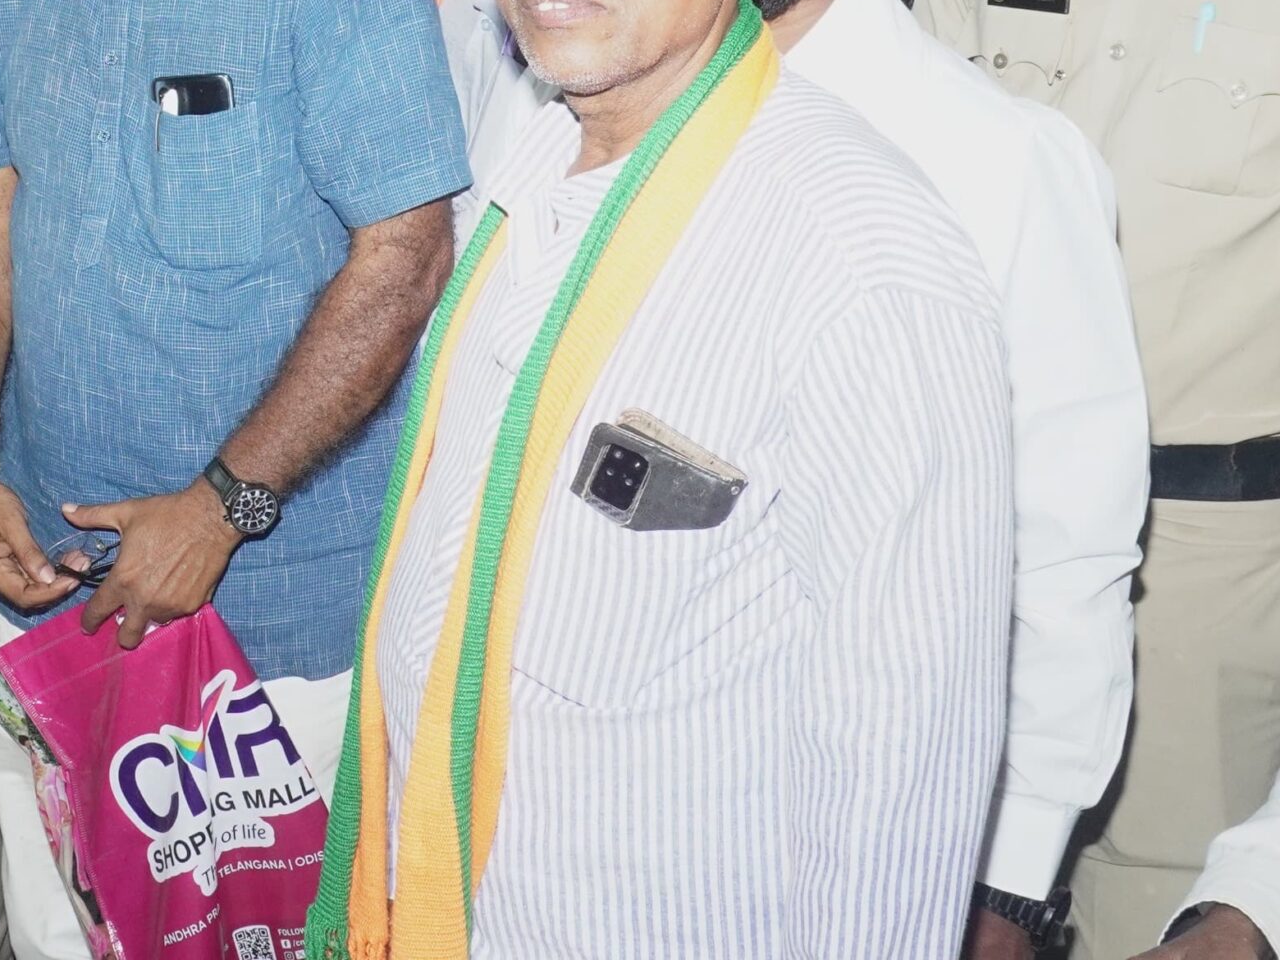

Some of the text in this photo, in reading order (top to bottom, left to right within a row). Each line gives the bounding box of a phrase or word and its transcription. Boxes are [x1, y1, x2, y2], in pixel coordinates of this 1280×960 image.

[118, 680, 302, 834] CMR
[242, 775, 316, 809] MALL
[221, 824, 238, 843] of
[242, 822, 267, 840] life
[163, 919, 207, 946] ANDHRA
[218, 859, 287, 878] TELANGANA
[295, 850, 324, 867] ODIS
